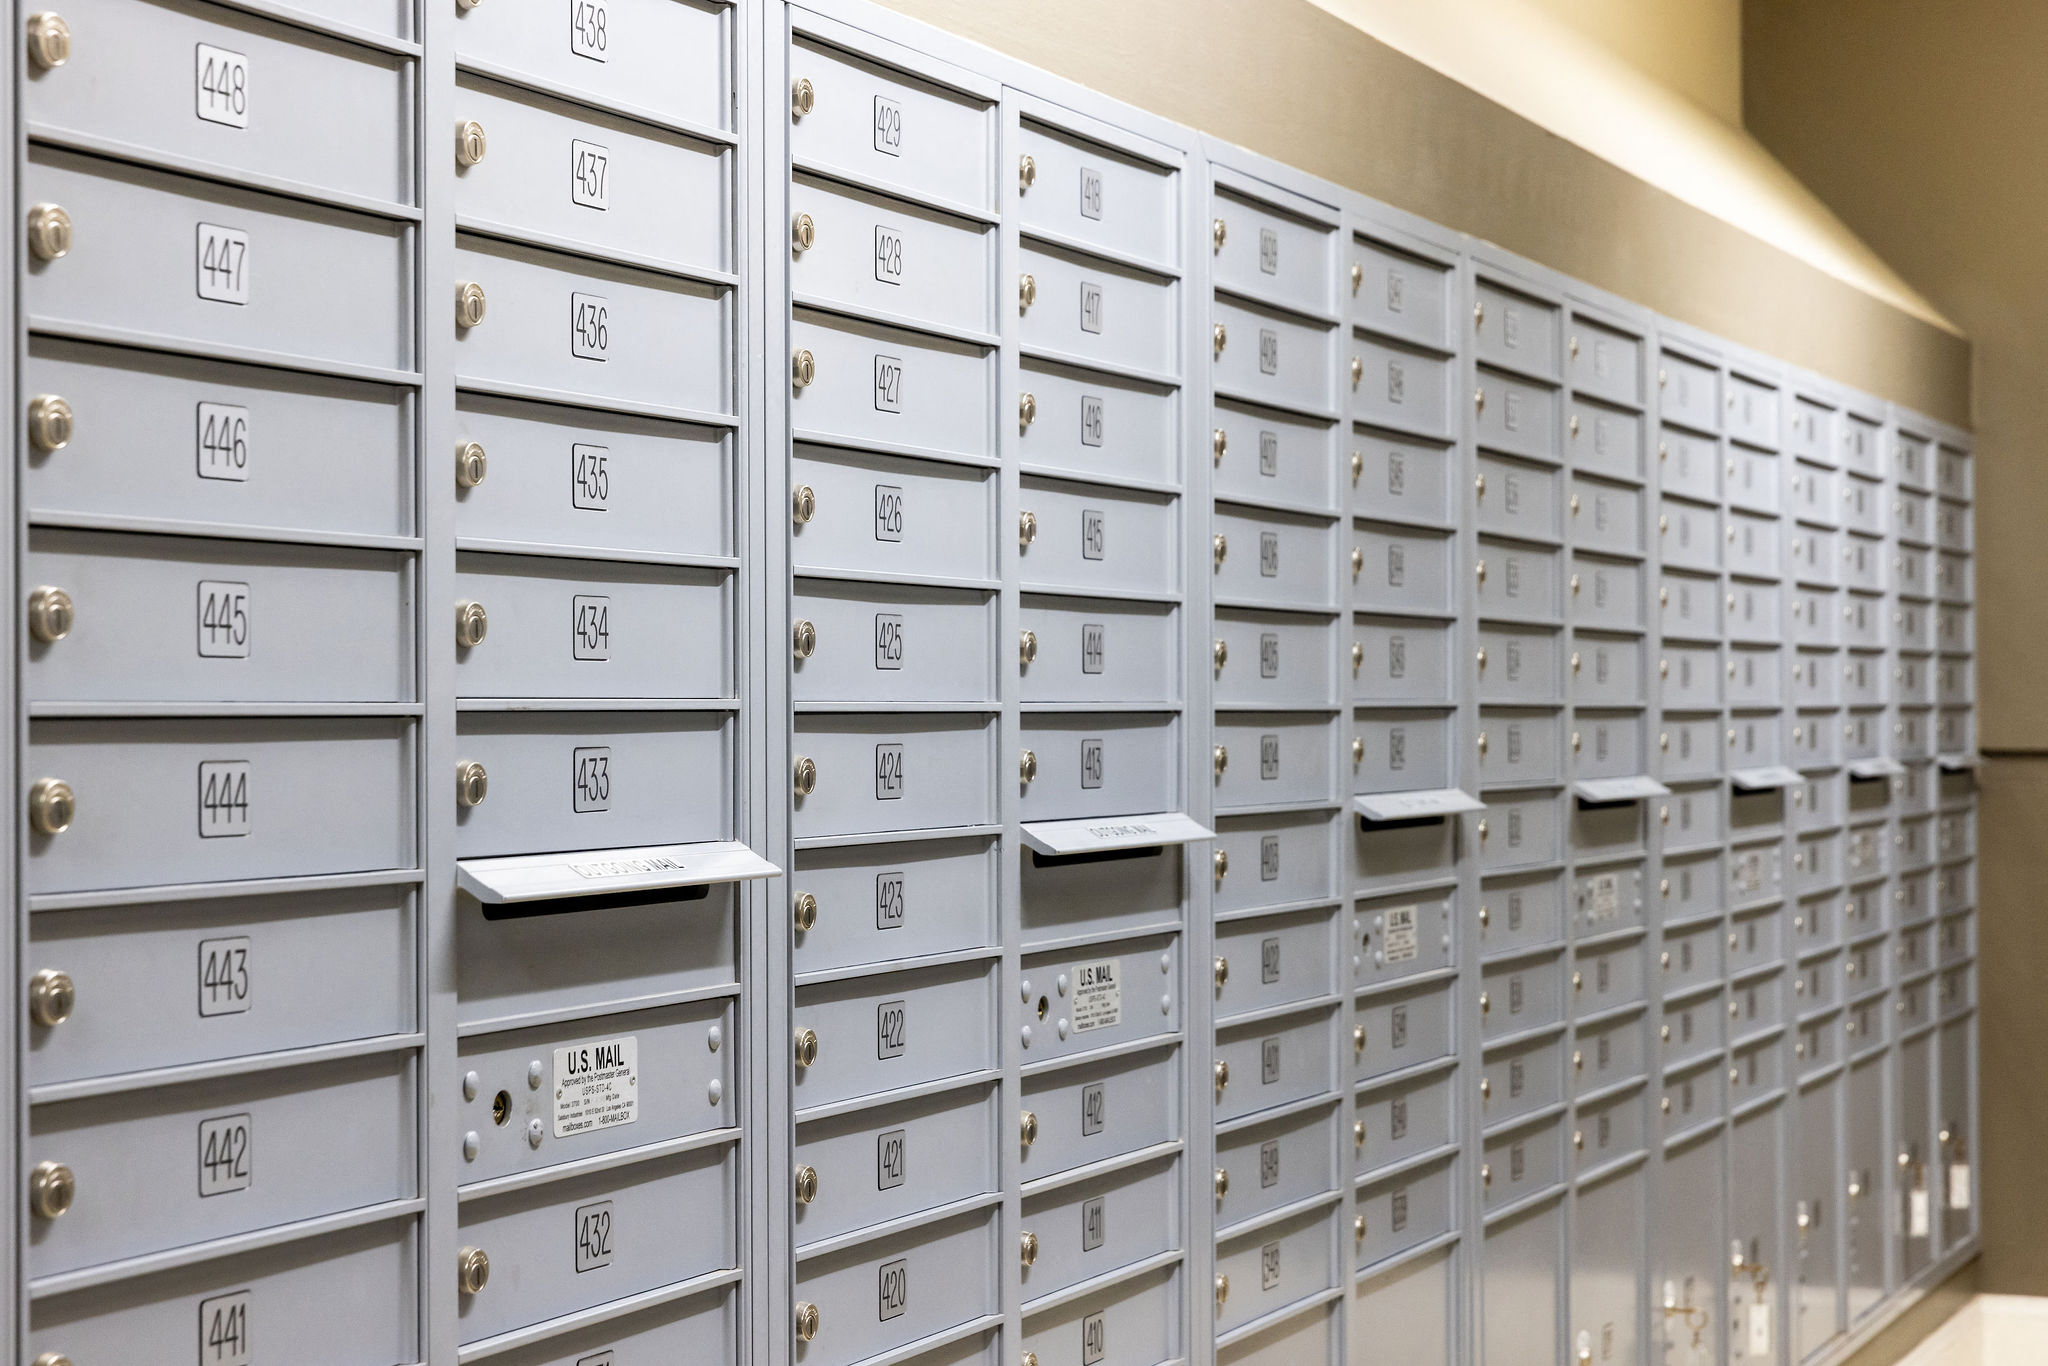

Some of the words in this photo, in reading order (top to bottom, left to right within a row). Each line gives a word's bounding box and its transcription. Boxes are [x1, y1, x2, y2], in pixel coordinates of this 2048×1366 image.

[576, 1, 606, 51] 438
[203, 58, 245, 115] 448
[878, 106, 900, 147] 429
[577, 151, 606, 199] 437
[1085, 176, 1100, 212] 418
[204, 236, 244, 290] 447
[879, 235, 901, 275] 428
[576, 303, 607, 350] 436
[1084, 291, 1100, 326] 417
[879, 364, 901, 404] 427
[204, 414, 246, 468] 446
[1086, 404, 1100, 439] 416
[577, 454, 608, 500] 435
[879, 494, 901, 533] 426
[1086, 518, 1102, 552] 415
[204, 594, 246, 645] 445
[577, 605, 608, 649] 434
[879, 622, 902, 660] 425
[1086, 632, 1102, 664] 414
[578, 757, 609, 801] 433
[879, 752, 902, 790] 424
[1085, 747, 1100, 780] 413
[204, 772, 248, 823] 444
[574, 860, 651, 876] OUTGOING
[644, 858, 685, 871] MAIL
[880, 881, 903, 919] 423
[204, 949, 248, 1002] 443
[1080, 968, 1094, 986] U.S.
[1096, 965, 1112, 983] MAIL
[881, 1009, 904, 1049] 422
[562, 1077, 581, 1089] Approved
[581, 1076, 586, 1085] by
[594, 1071, 615, 1081] Postmaster
[616, 1067, 630, 1078] General
[568, 1050, 591, 1074] U.S.
[596, 1044, 624, 1070] MAIL
[562, 1120, 592, 1132] mailboxes.com
[599, 1111, 630, 1126] 1-800-MAILBOX
[1087, 1091, 1102, 1127] 412
[204, 1126, 247, 1181] 442
[884, 1139, 902, 1179] 421
[580, 1211, 611, 1259] 432
[1088, 1205, 1101, 1240] 411
[882, 1268, 906, 1310] 420
[210, 1303, 246, 1360] 441
[1087, 1319, 1103, 1356] 410
